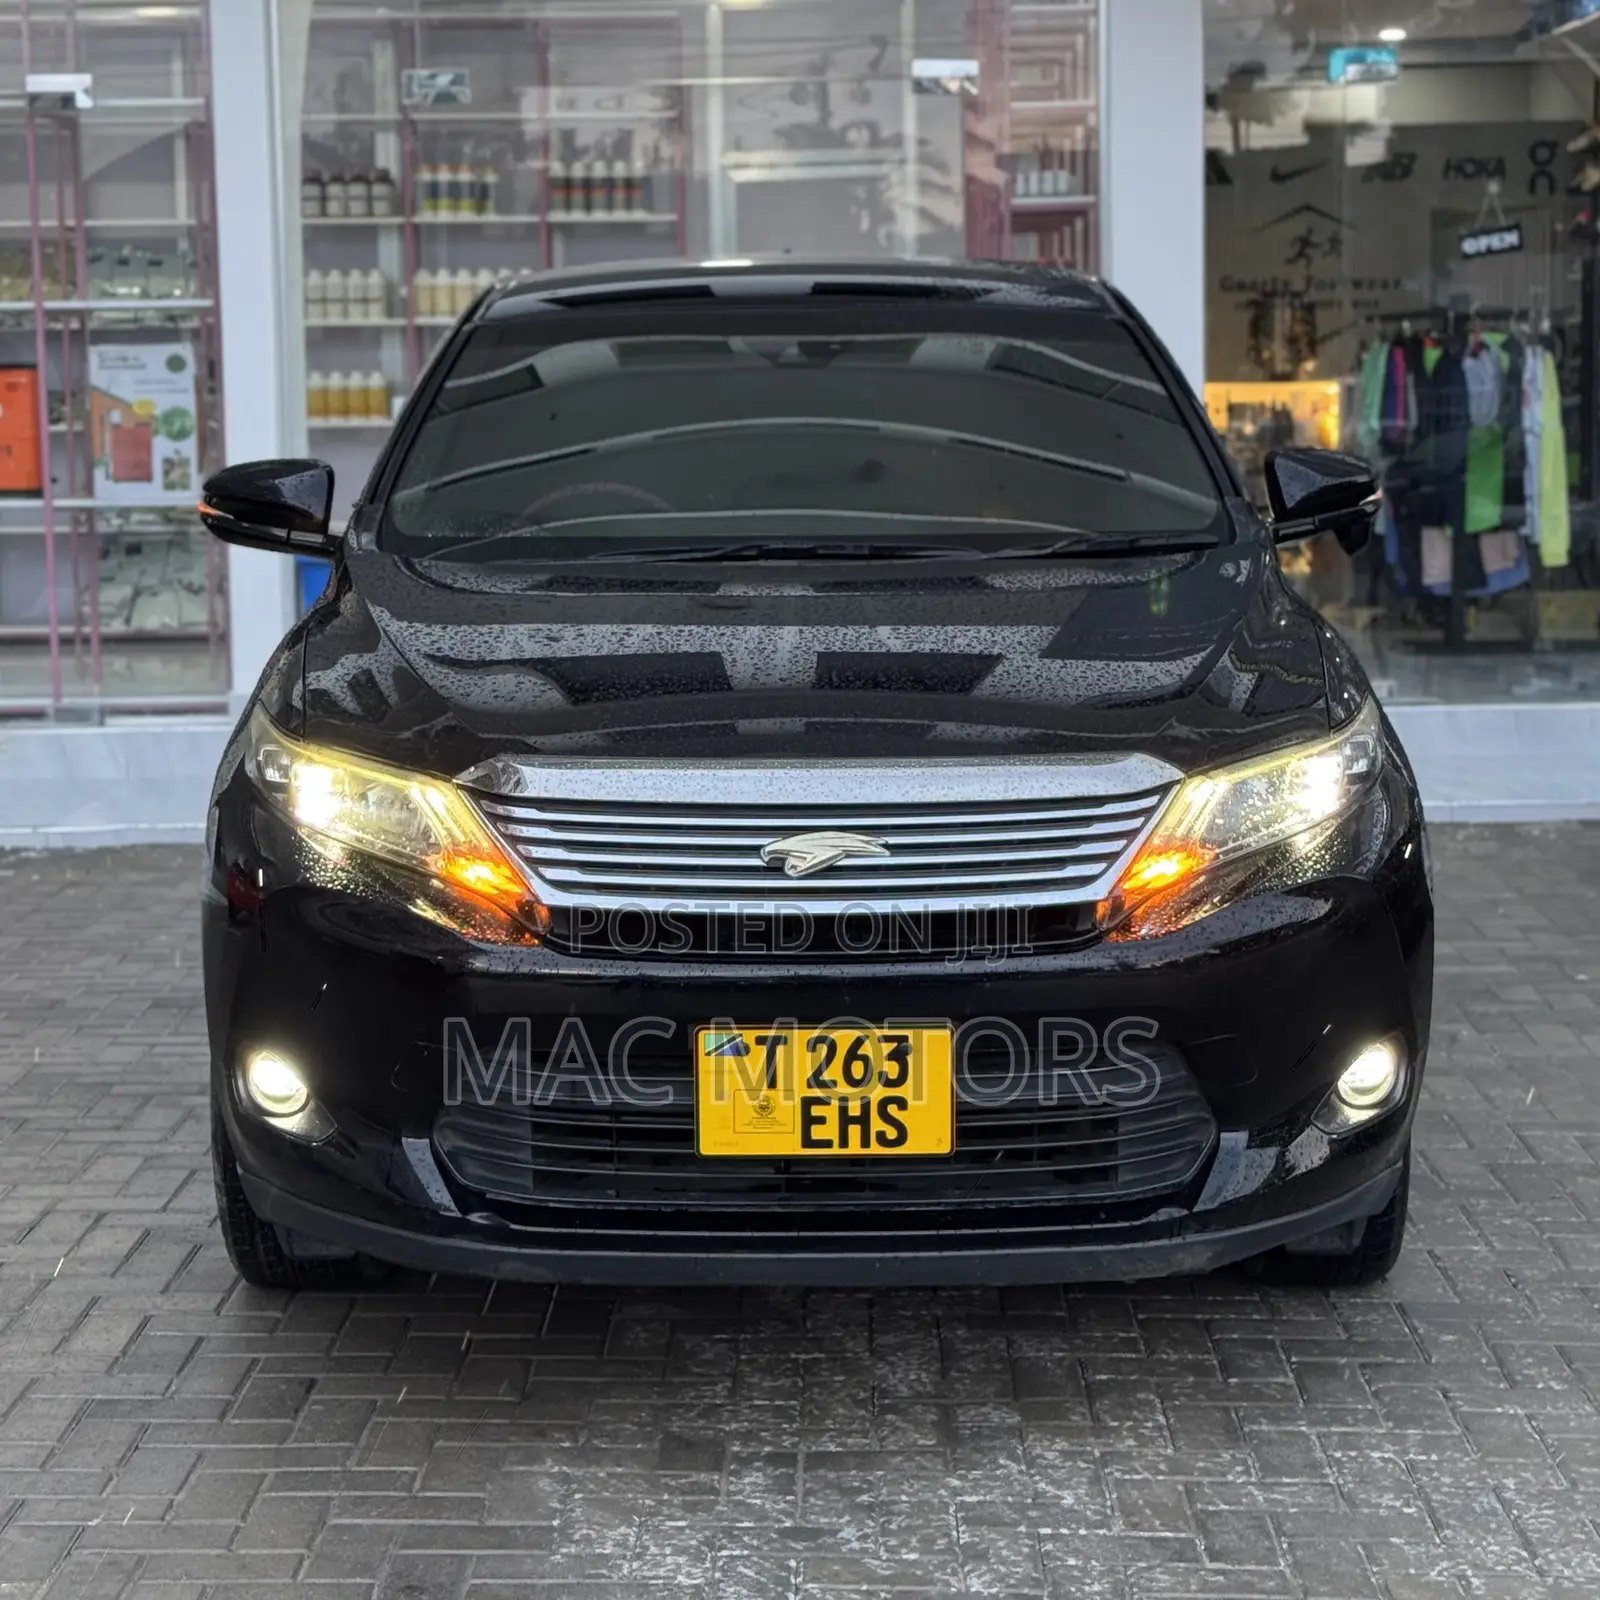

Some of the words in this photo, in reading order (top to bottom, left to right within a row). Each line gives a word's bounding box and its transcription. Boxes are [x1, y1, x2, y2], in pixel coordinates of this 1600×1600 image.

[1460, 229, 1520, 256] OPEN
[755, 1035, 789, 1089] T
[806, 1035, 910, 1089] 263
[801, 1096, 909, 1149] EHS
